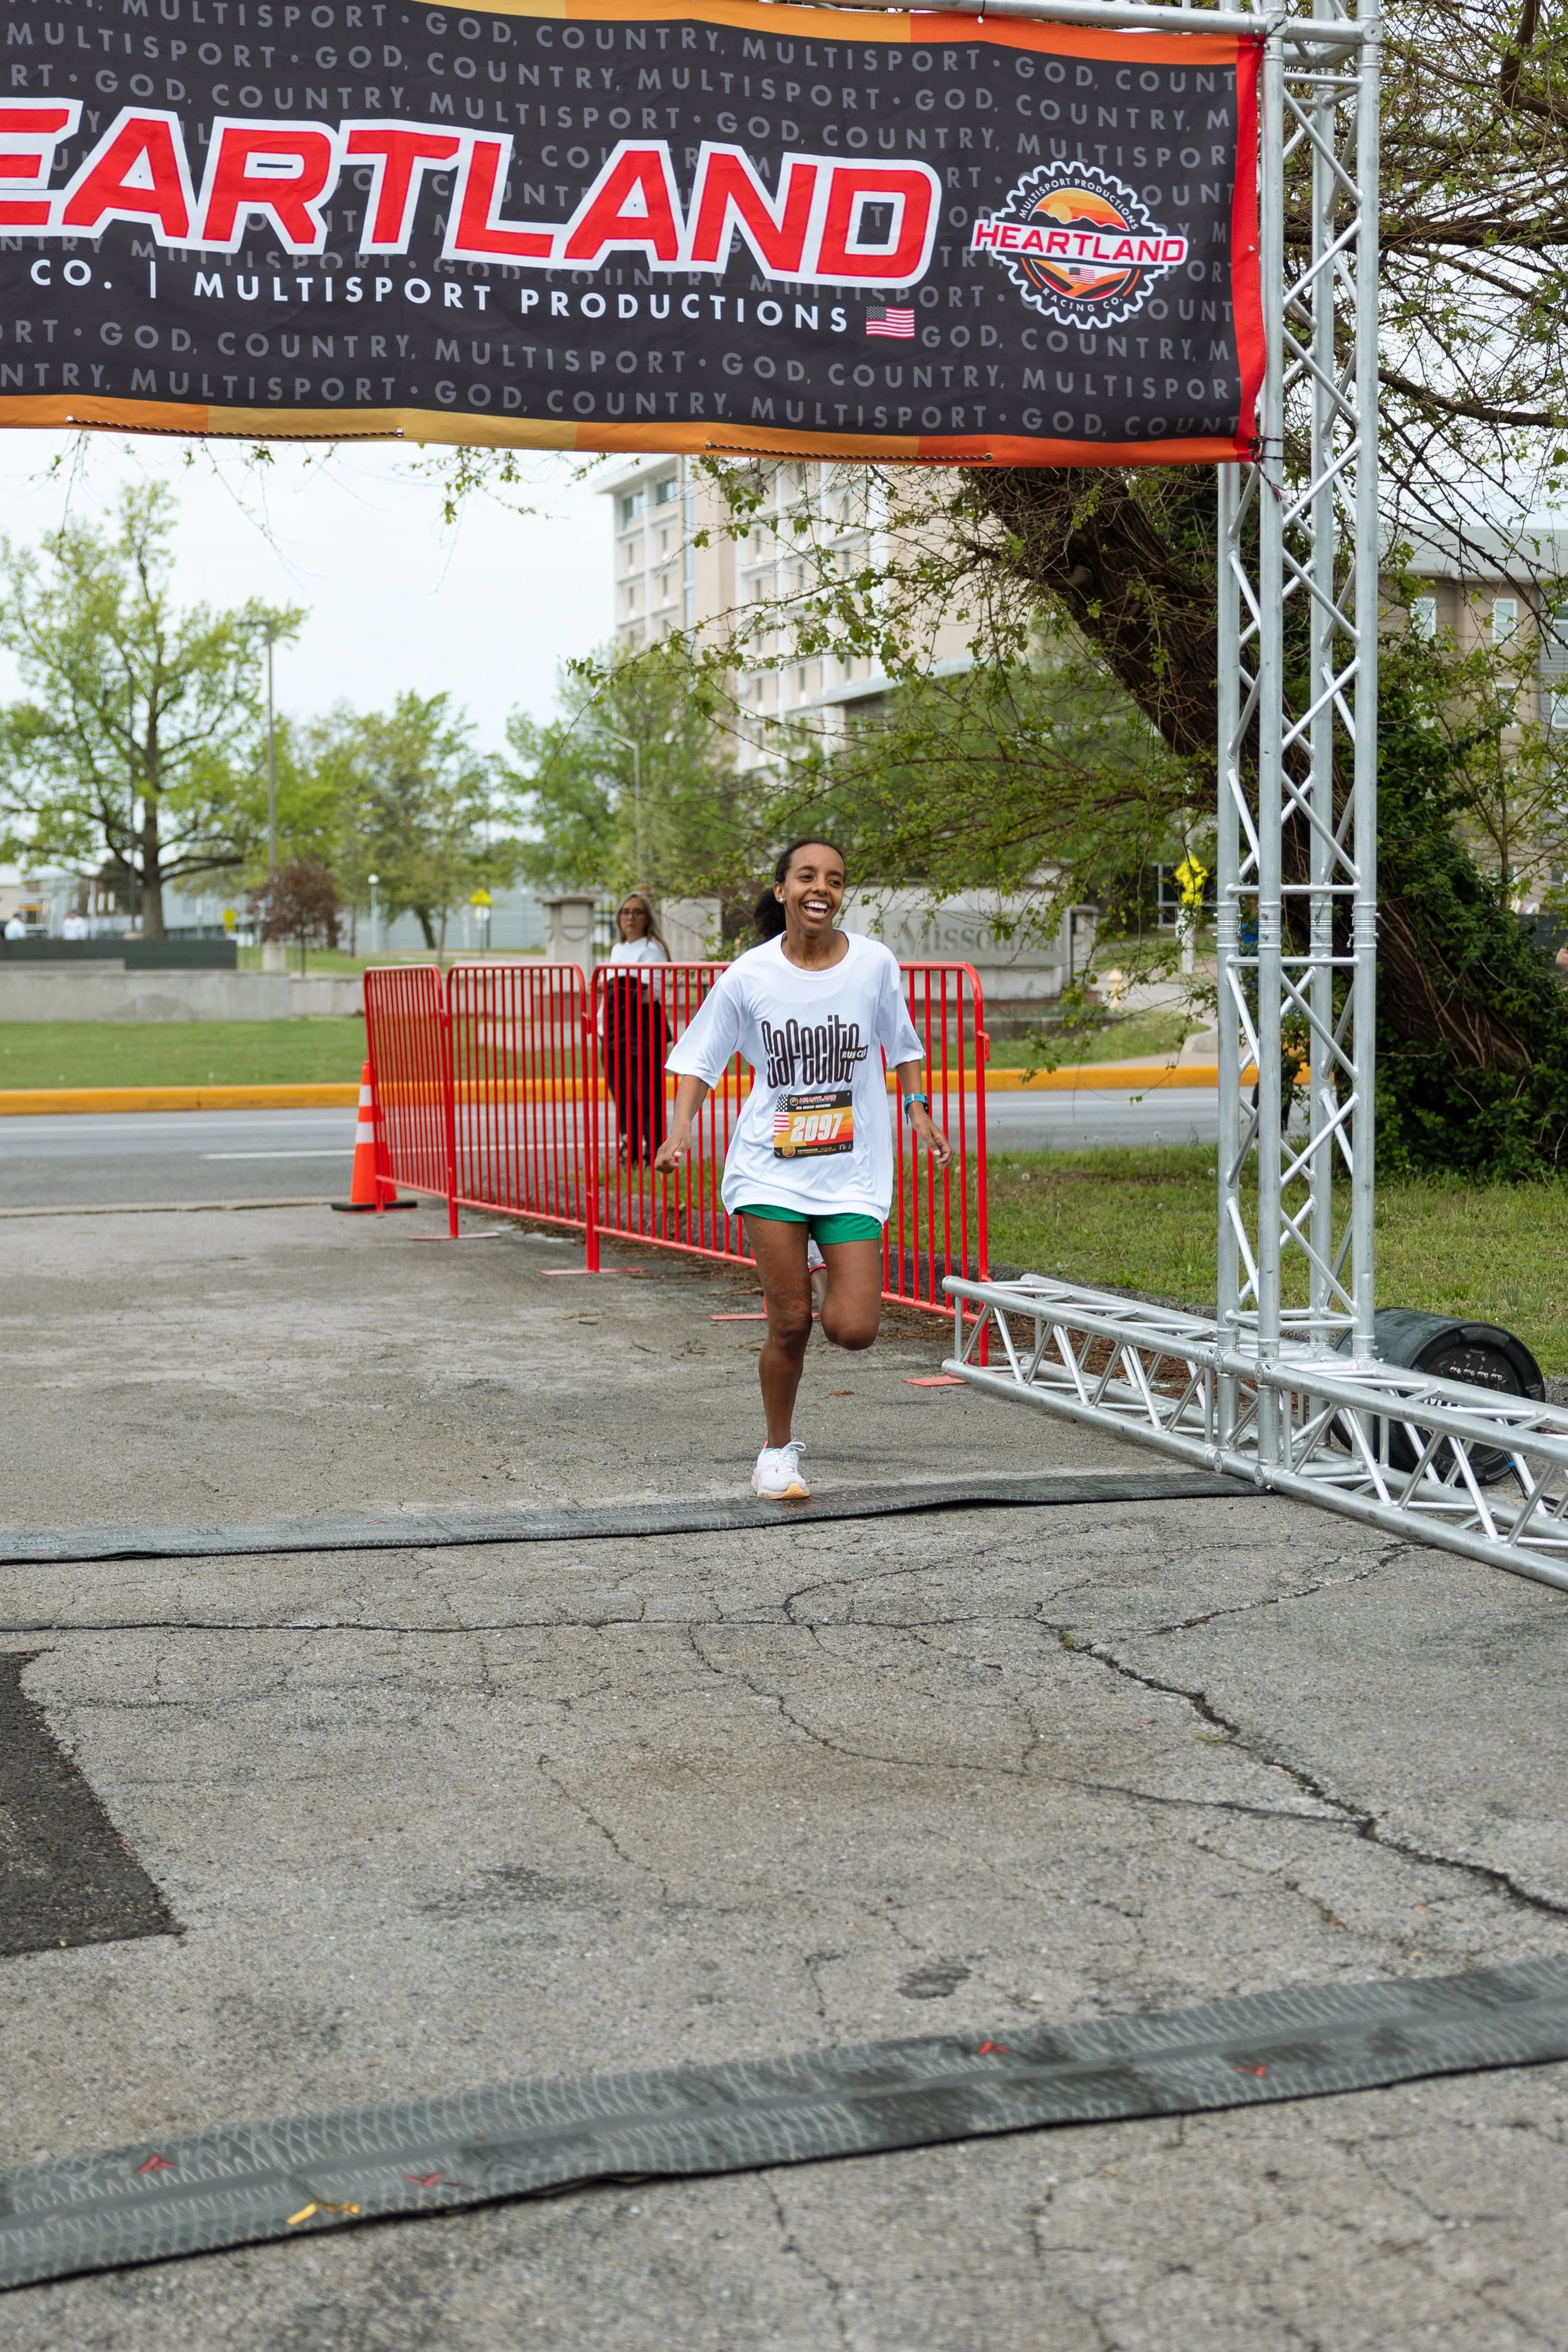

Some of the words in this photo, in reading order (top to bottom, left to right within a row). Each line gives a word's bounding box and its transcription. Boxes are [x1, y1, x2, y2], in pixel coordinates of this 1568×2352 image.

[123, 0, 386, 29] MULTISPORT
[426, 13, 517, 47] GOD,
[537, 26, 725, 55] COUNTRY,
[743, 38, 980, 72] MULTISPORT
[1016, 57, 1098, 90] GOD,
[8, 23, 276, 68] MULTISPORT
[316, 46, 409, 71] GOD,
[428, 53, 620, 92] COUNTRY,
[638, 68, 880, 110] MULTISPORT
[916, 88, 999, 113] GOD,
[1017, 95, 1190, 132] COUNTRY,
[96, 70, 192, 105] GOD,
[212, 85, 410, 112] COUNTRY,
[430, 92, 681, 130] MULTISPORT
[718, 112, 805, 145] GOD,
[823, 125, 1000, 152] COUNTRY,
[1019, 178, 1071, 219] MULTISPORT
[1075, 178, 1139, 230] PRODUCTIONS
[1123, 183, 1234, 206] OUNT
[975, 223, 1184, 262] HEARTLAND
[31, 260, 111, 289] CO.
[194, 272, 490, 310] MULTISPORT
[522, 290, 847, 332] PRODUCTIONS
[1042, 288, 1094, 312] RACING
[1103, 297, 1123, 310] CO.
[1130, 299, 1231, 322] OUNT
[0, 320, 58, 344] RT
[100, 322, 198, 355] GOD,
[218, 332, 416, 360] COUNTRY,
[435, 339, 686, 374] MULTISPORT
[723, 353, 811, 385] GOD,
[829, 364, 1005, 389] COUNTRY,
[922, 326, 1004, 349] GOD,
[1022, 329, 1196, 363] COUNTRY,
[131, 369, 396, 401] MULTISPORT
[435, 381, 527, 411] GOD,
[548, 390, 733, 418] COUNTRY,
[752, 397, 987, 429] MULTISPORT
[1023, 408, 1106, 437] GOD,
[790, 1113, 843, 1142] 2097
